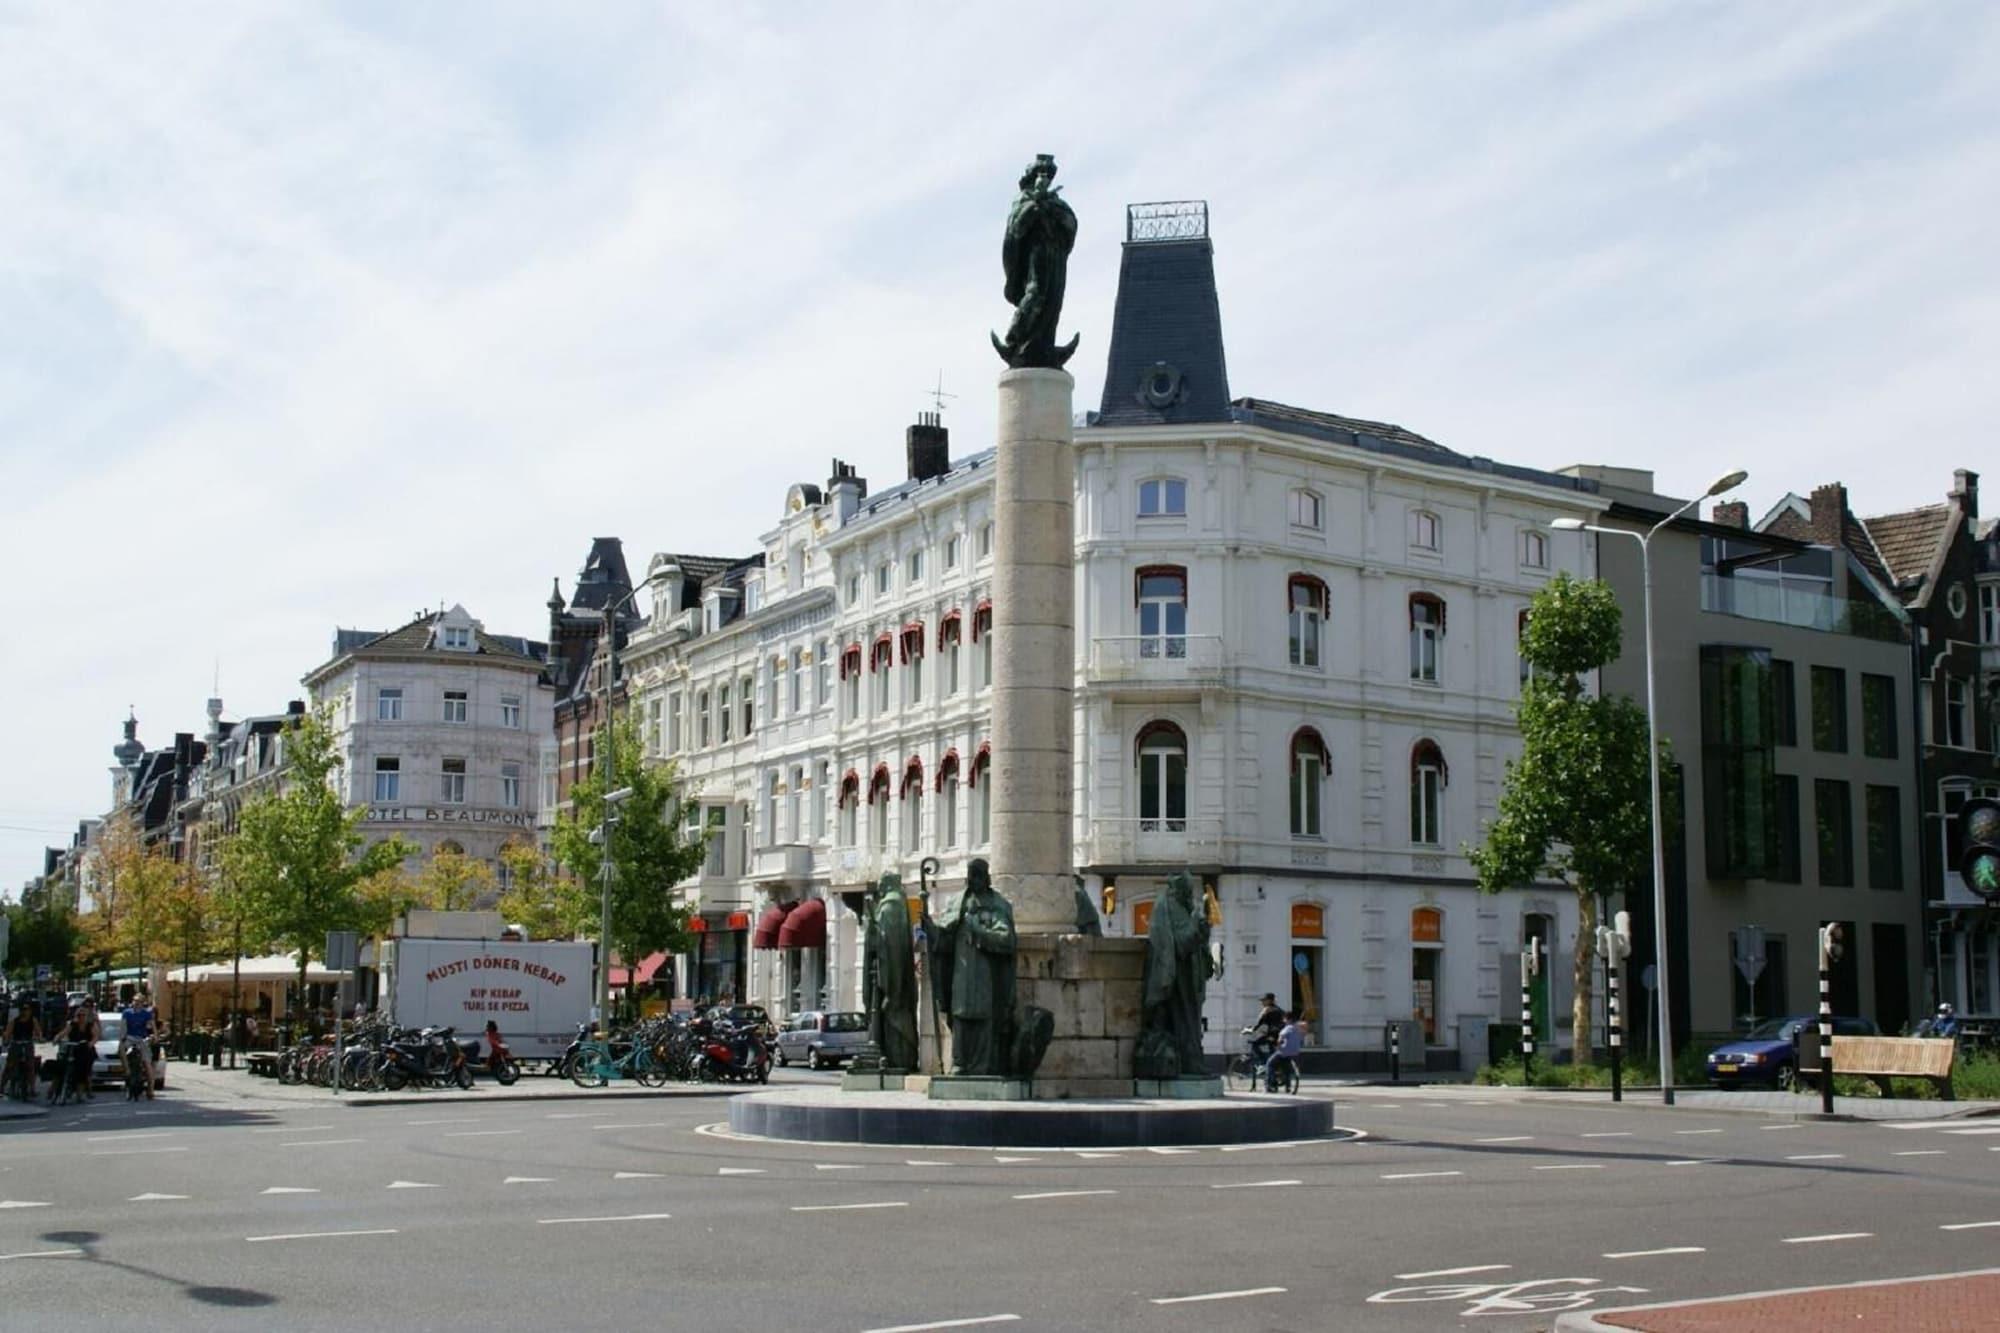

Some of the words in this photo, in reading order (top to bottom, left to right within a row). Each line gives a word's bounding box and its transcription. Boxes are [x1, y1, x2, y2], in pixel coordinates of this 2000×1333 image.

[365, 808, 414, 821] OTEL
[425, 808, 537, 826] BEAUMONT
[426, 960, 468, 983] MUSTI
[472, 954, 520, 971] DÖNER
[524, 962, 567, 987] KEBAP
[470, 989, 488, 999] KIP
[490, 989, 522, 999] KEBAP
[502, 1001, 530, 1012] PIZZA
